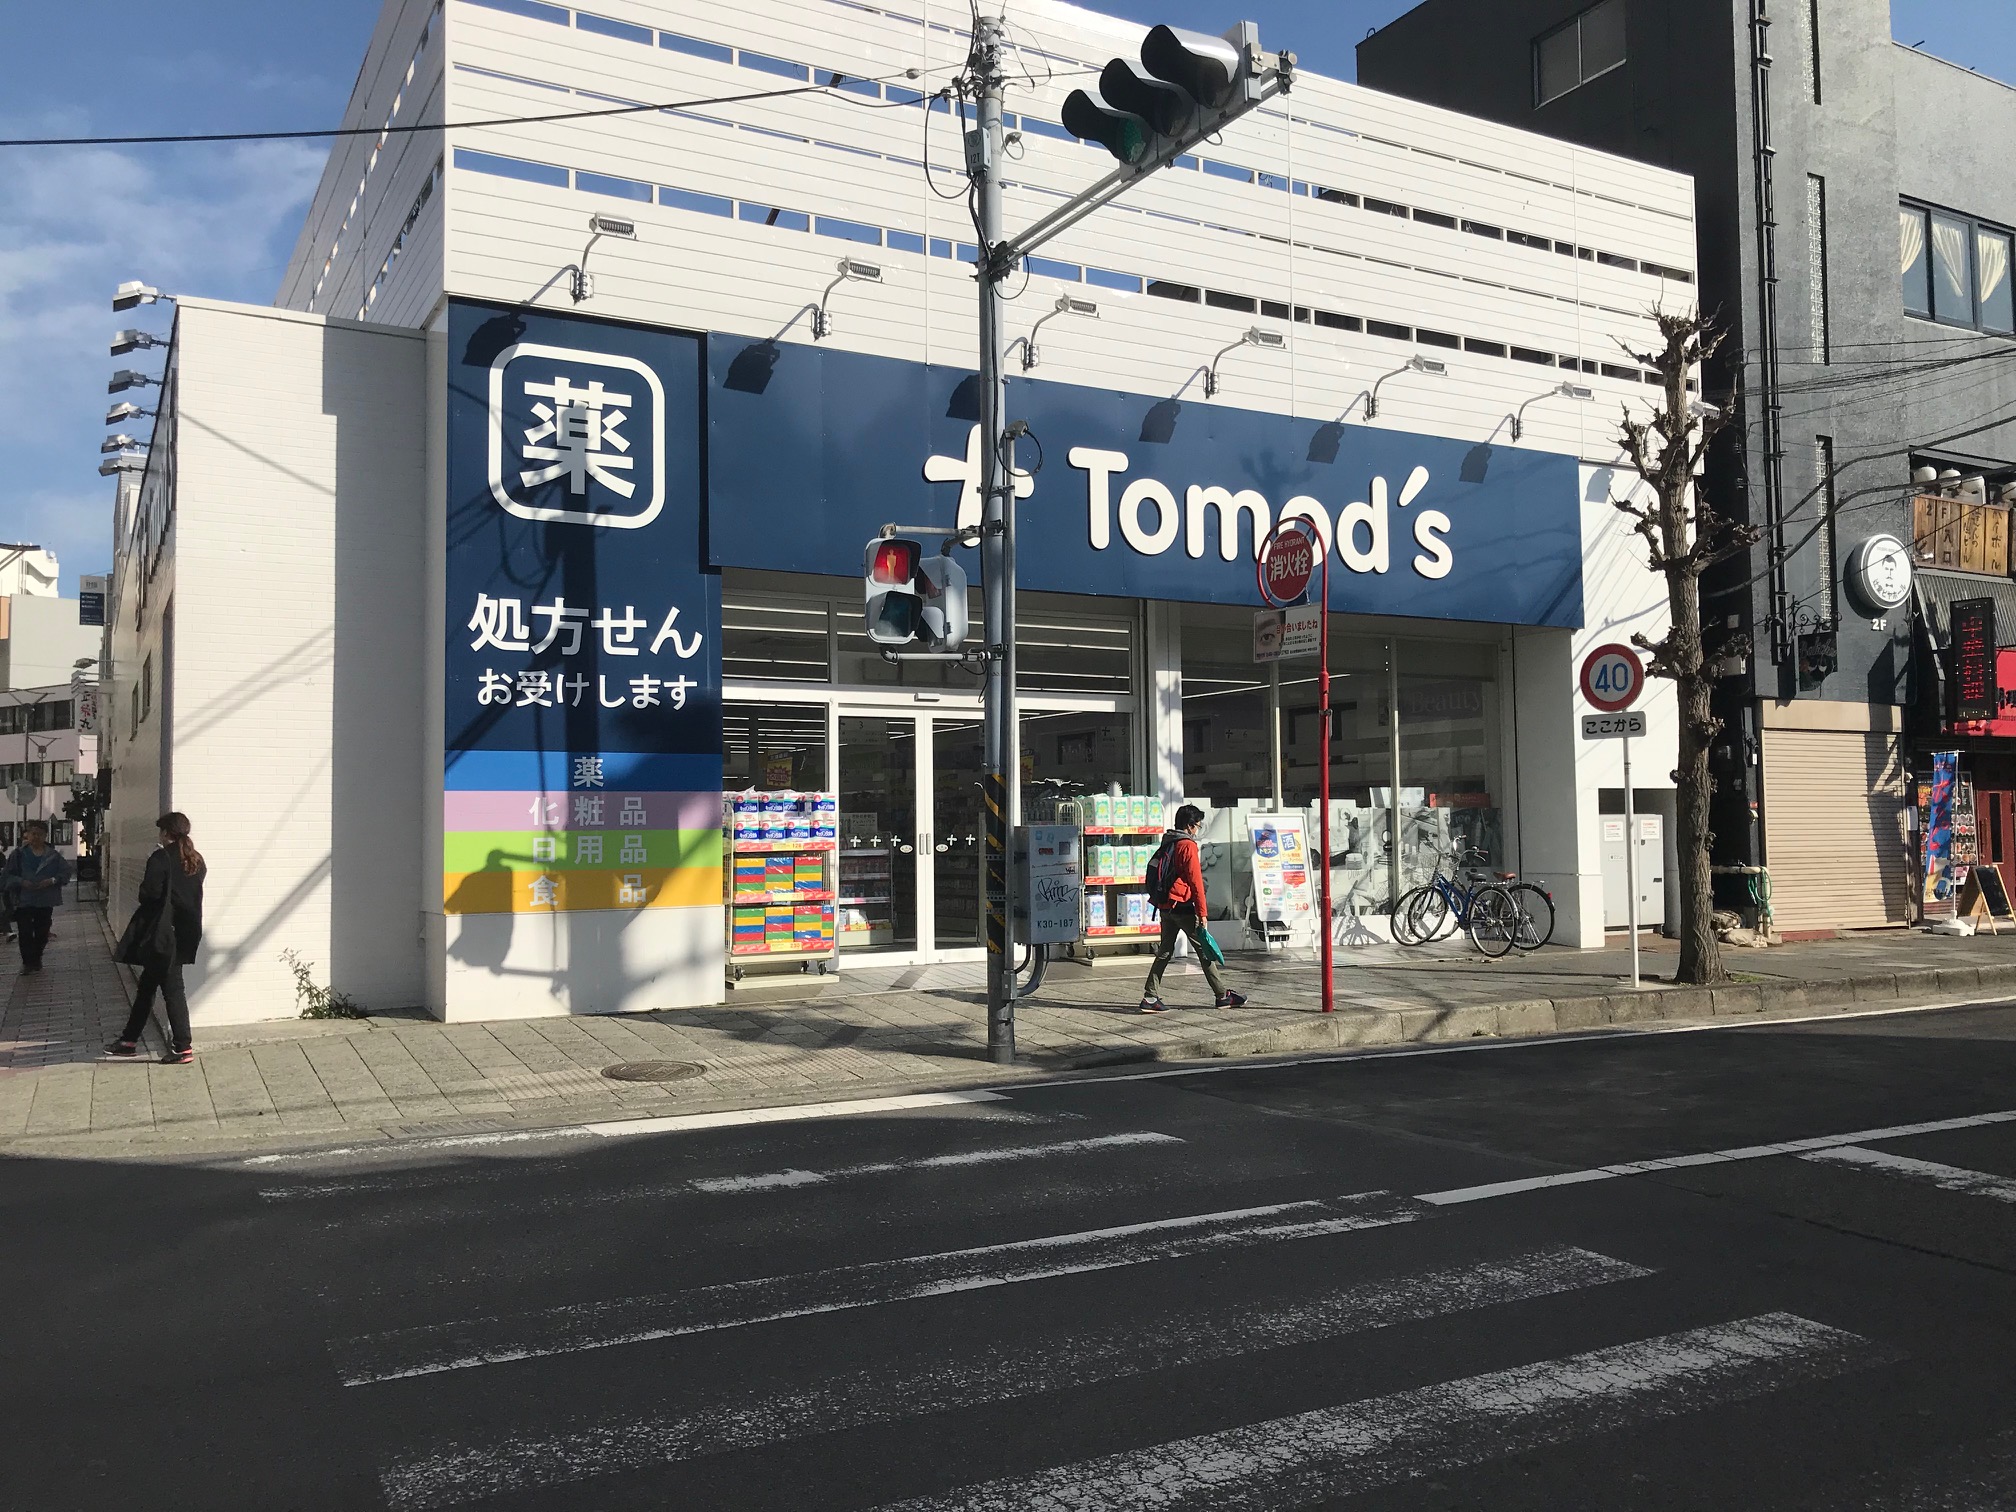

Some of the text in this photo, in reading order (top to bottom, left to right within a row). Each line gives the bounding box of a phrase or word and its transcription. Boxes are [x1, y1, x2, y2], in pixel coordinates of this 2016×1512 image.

[519, 376, 636, 499] 薬
[1068, 446, 1454, 580] Tomod's
[1273, 536, 1305, 551] FIRE HYDRANT
[1270, 548, 1310, 582] 消火栓
[468, 593, 703, 659] 処方せん
[1872, 618, 1887, 631] 2F
[477, 668, 698, 711] お受けします
[1595, 662, 1629, 693] 40
[1585, 717, 1641, 734] ここから
[573, 756, 604, 788] 薬
[528, 796, 647, 826] 化粧品
[532, 834, 647, 864] 日用品
[1282, 834, 1295, 849] 酒
[528, 874, 647, 906] 食品
[1037, 918, 1074, 929] K30-187
